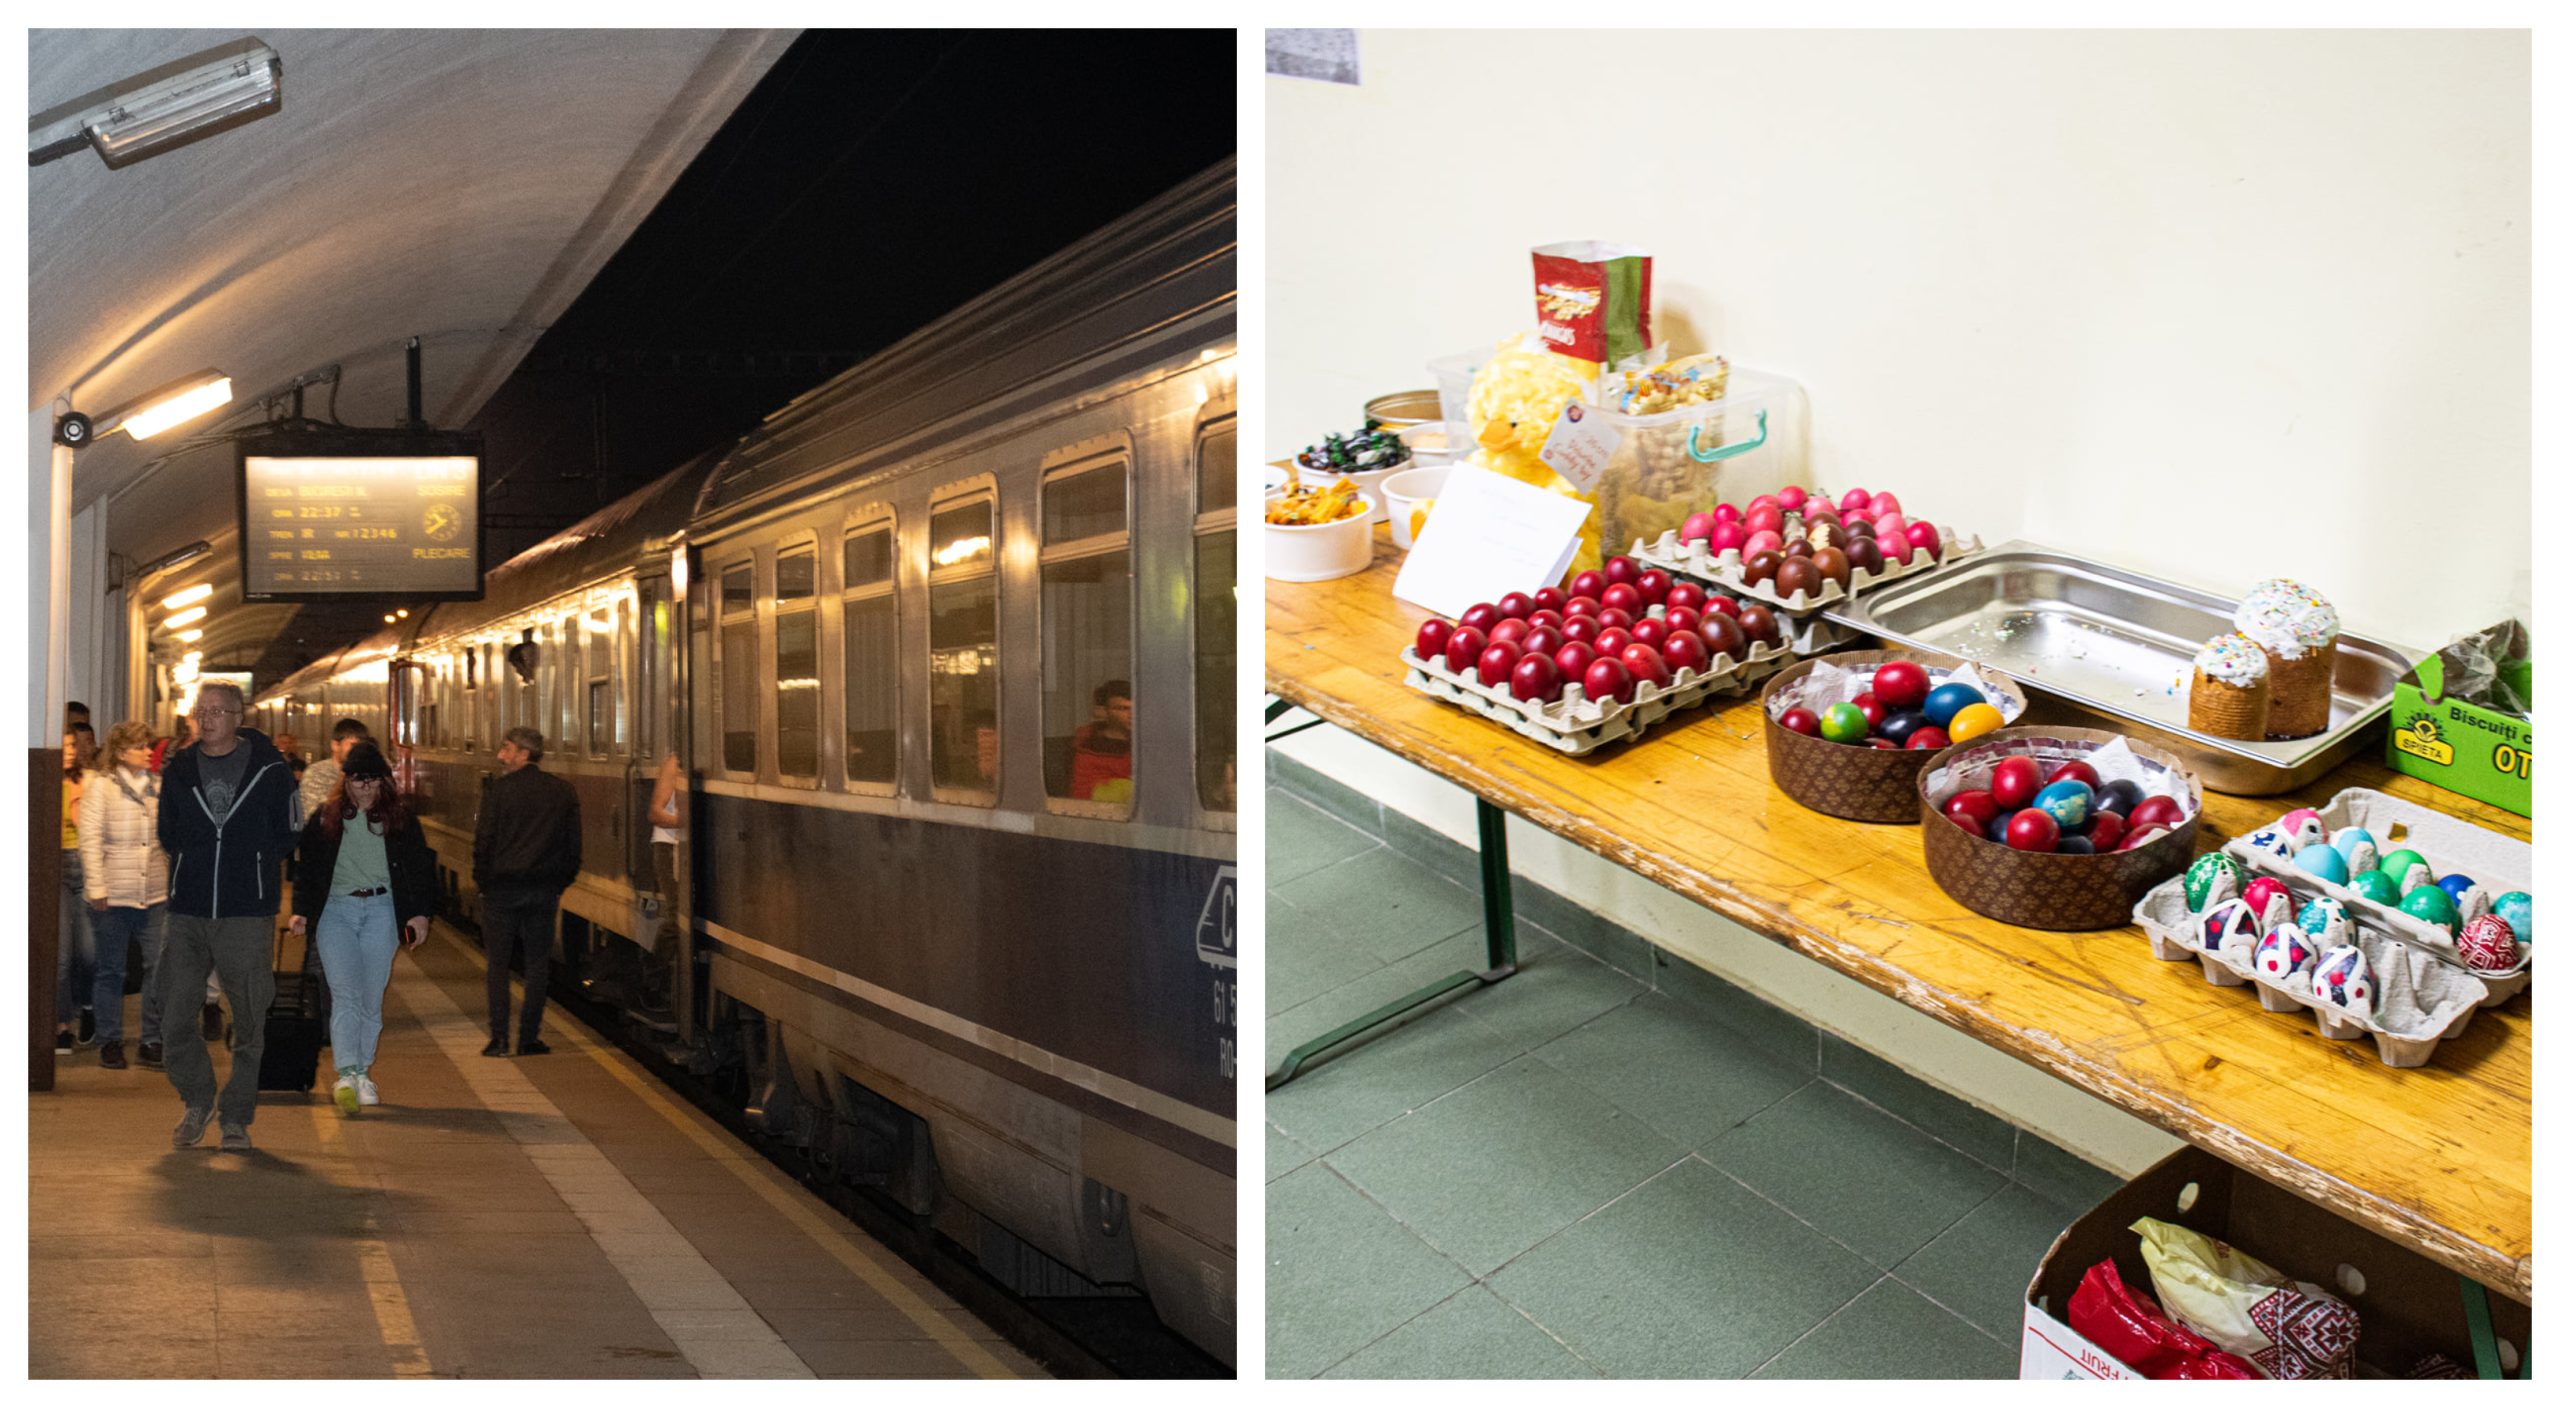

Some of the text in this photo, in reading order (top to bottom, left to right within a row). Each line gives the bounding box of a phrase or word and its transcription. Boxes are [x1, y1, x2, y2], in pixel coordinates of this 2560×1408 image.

[300, 506, 342, 518] 22:37
[412, 547, 470, 559] PLECARE
[2449, 706, 2518, 741] Biscuiți
[1222, 884, 1234, 949] C
[1214, 979, 1226, 1025] 61
[2080, 1348, 2119, 1380] FRUIT
